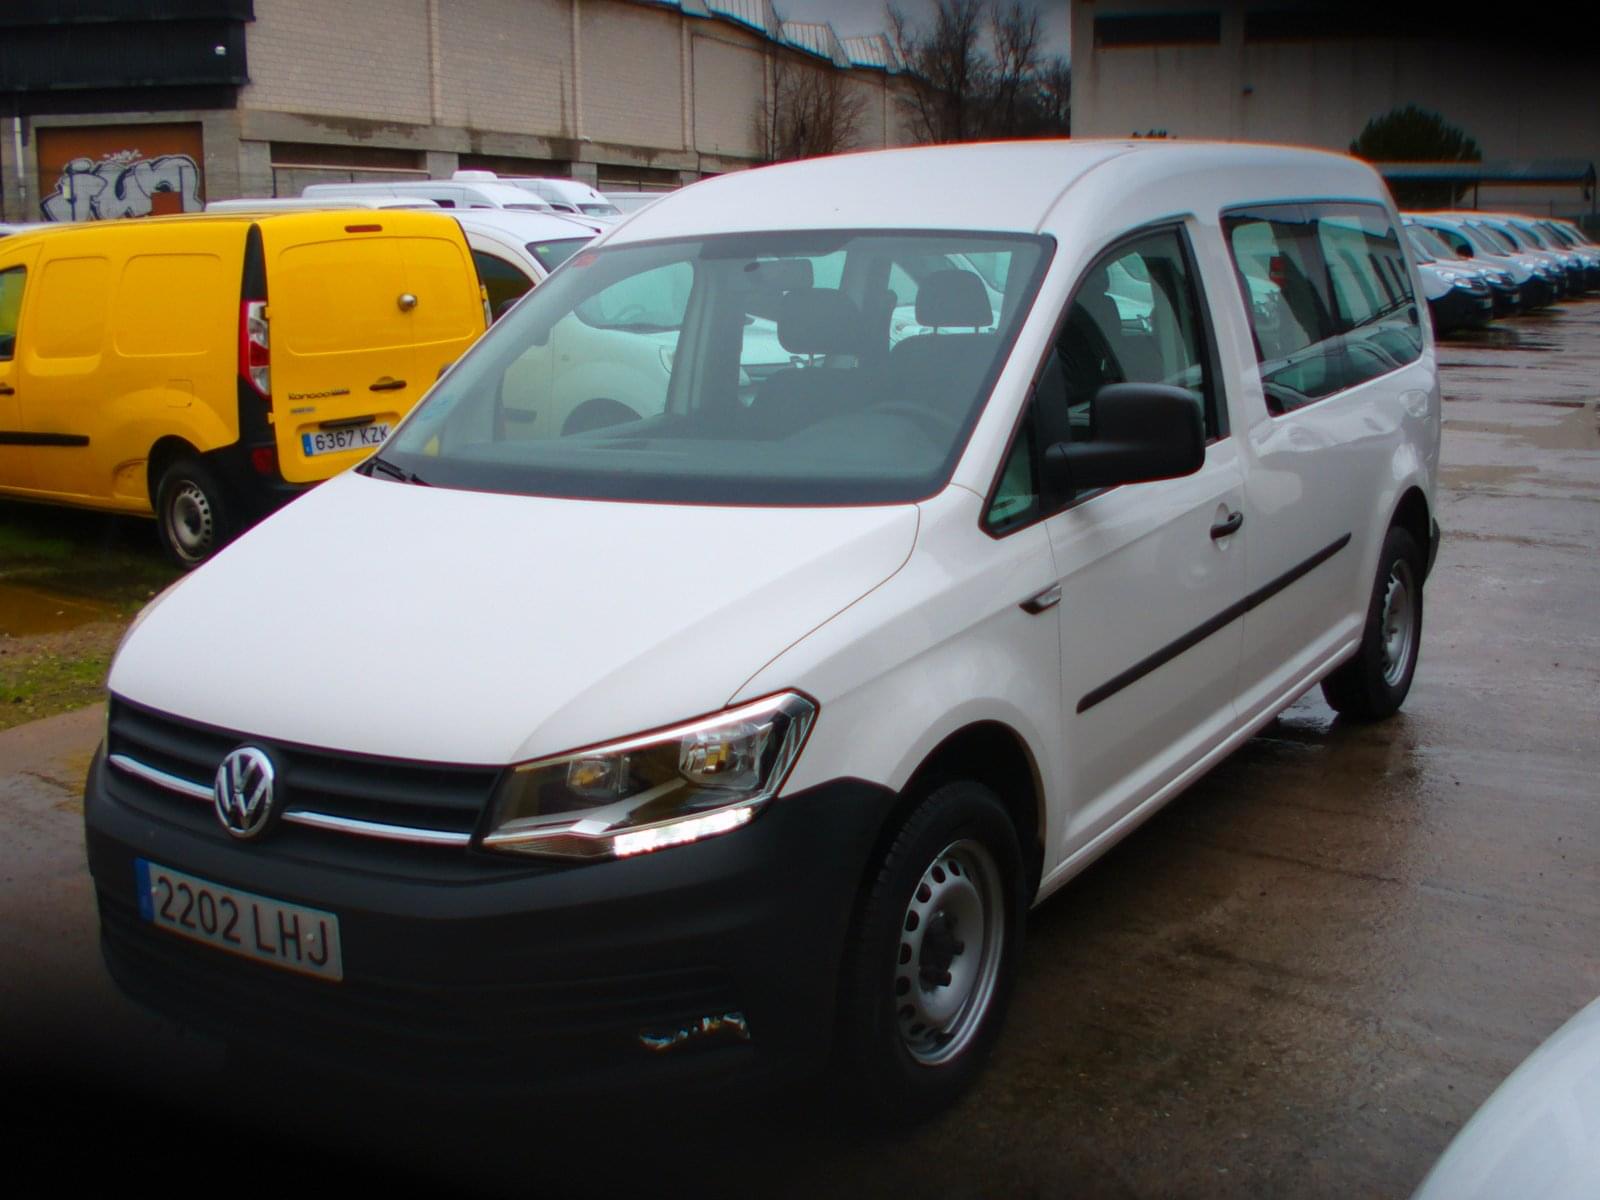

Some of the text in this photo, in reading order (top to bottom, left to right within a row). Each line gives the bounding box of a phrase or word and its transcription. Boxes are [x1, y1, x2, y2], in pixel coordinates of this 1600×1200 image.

[315, 424, 389, 451] 6367 KZK
[157, 875, 329, 967] 2202 LHJ
